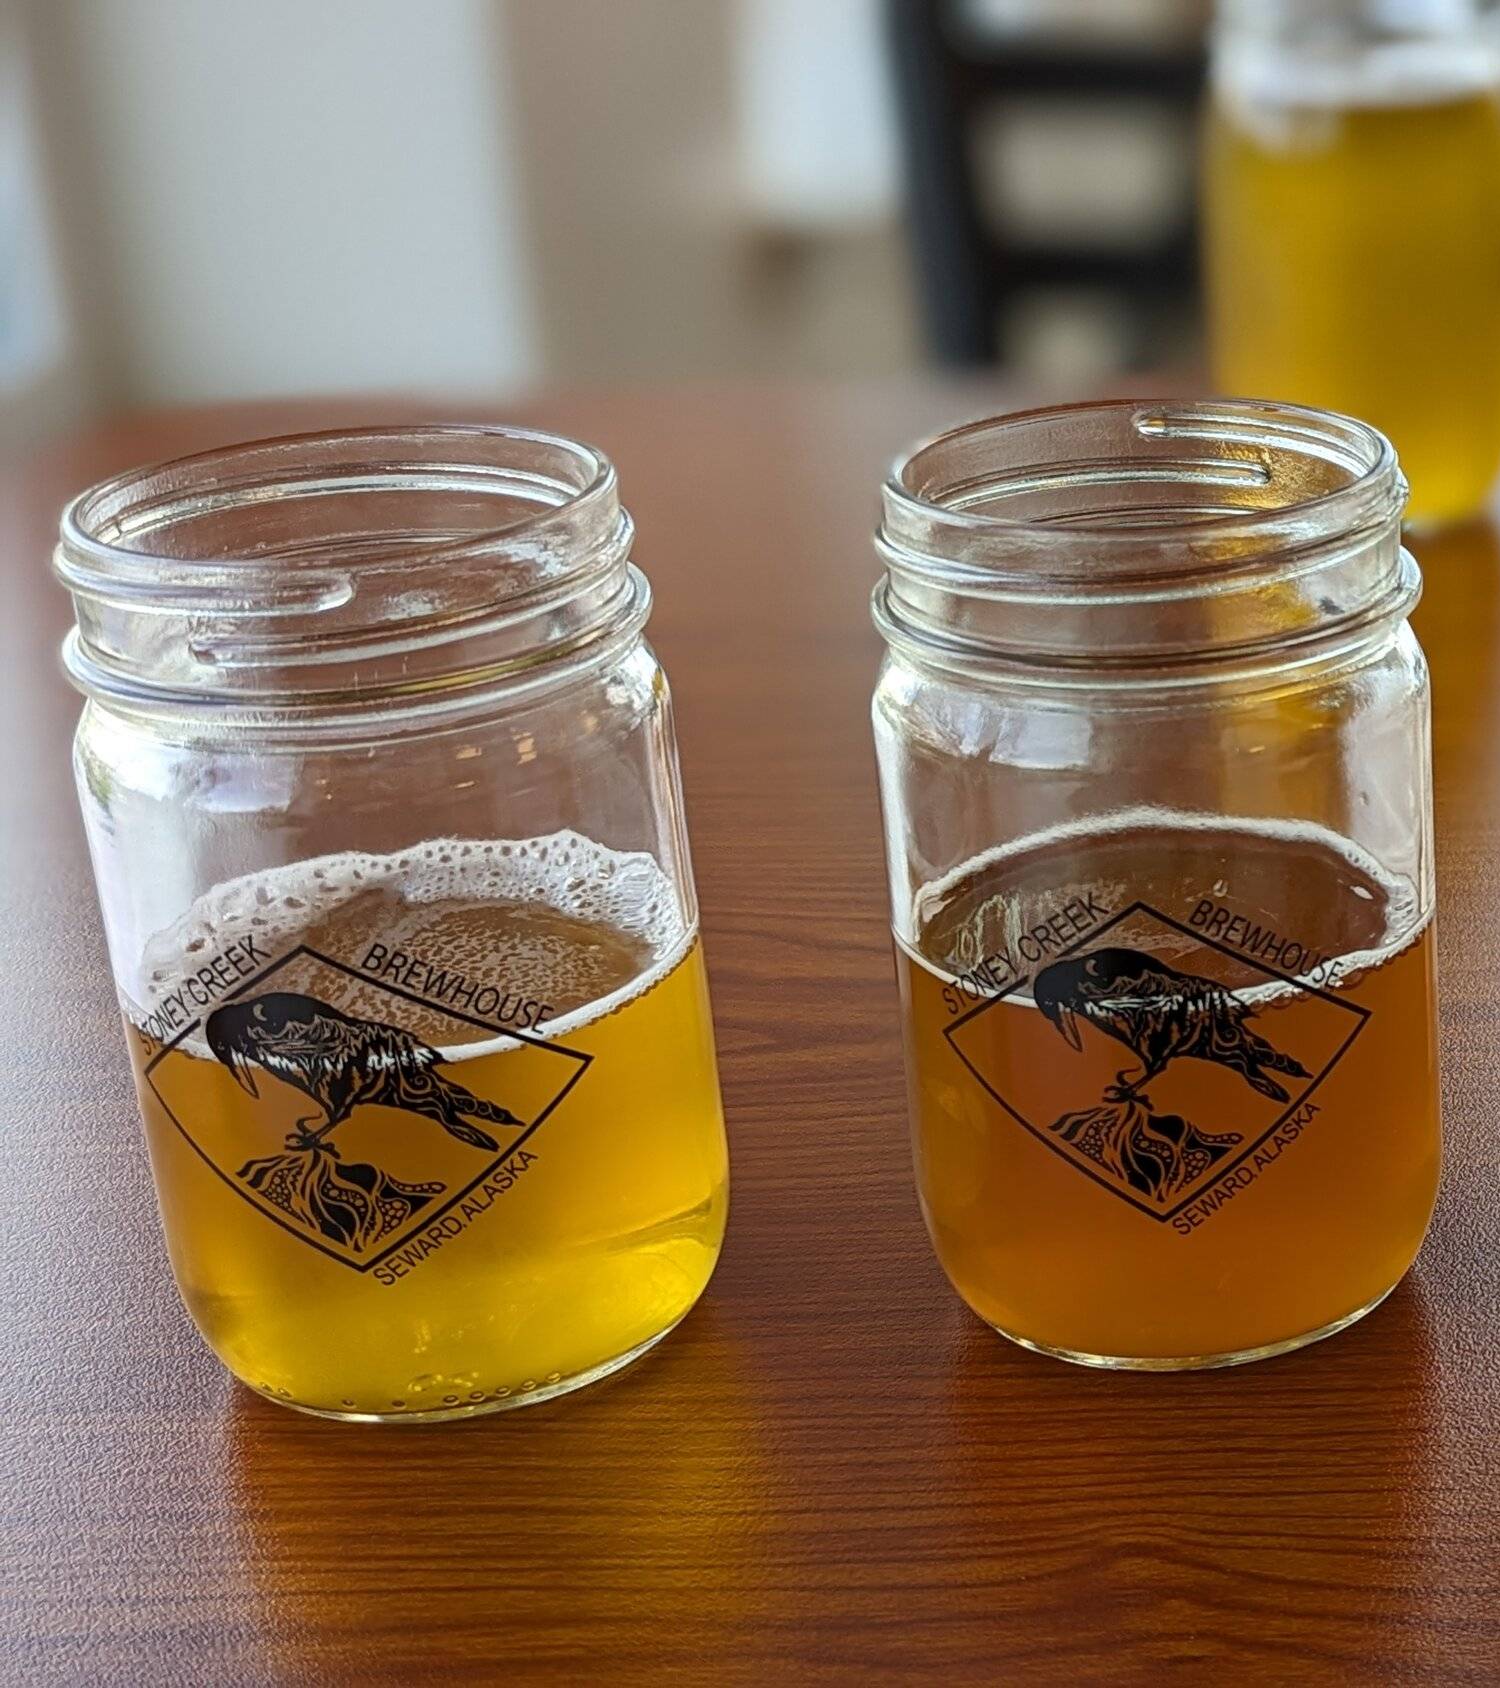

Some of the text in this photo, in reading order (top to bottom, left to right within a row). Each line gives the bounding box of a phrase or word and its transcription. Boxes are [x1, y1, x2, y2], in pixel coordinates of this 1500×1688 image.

[942, 892, 1110, 1016] STONEY CREEK
[1189, 899, 1345, 988] BREWHOUSE
[139, 934, 272, 1057] STONEY CREEK
[361, 943, 555, 1035] BREWHOUSE
[1253, 1102, 1322, 1173] ALASKA
[461, 1150, 539, 1222] ALASKA
